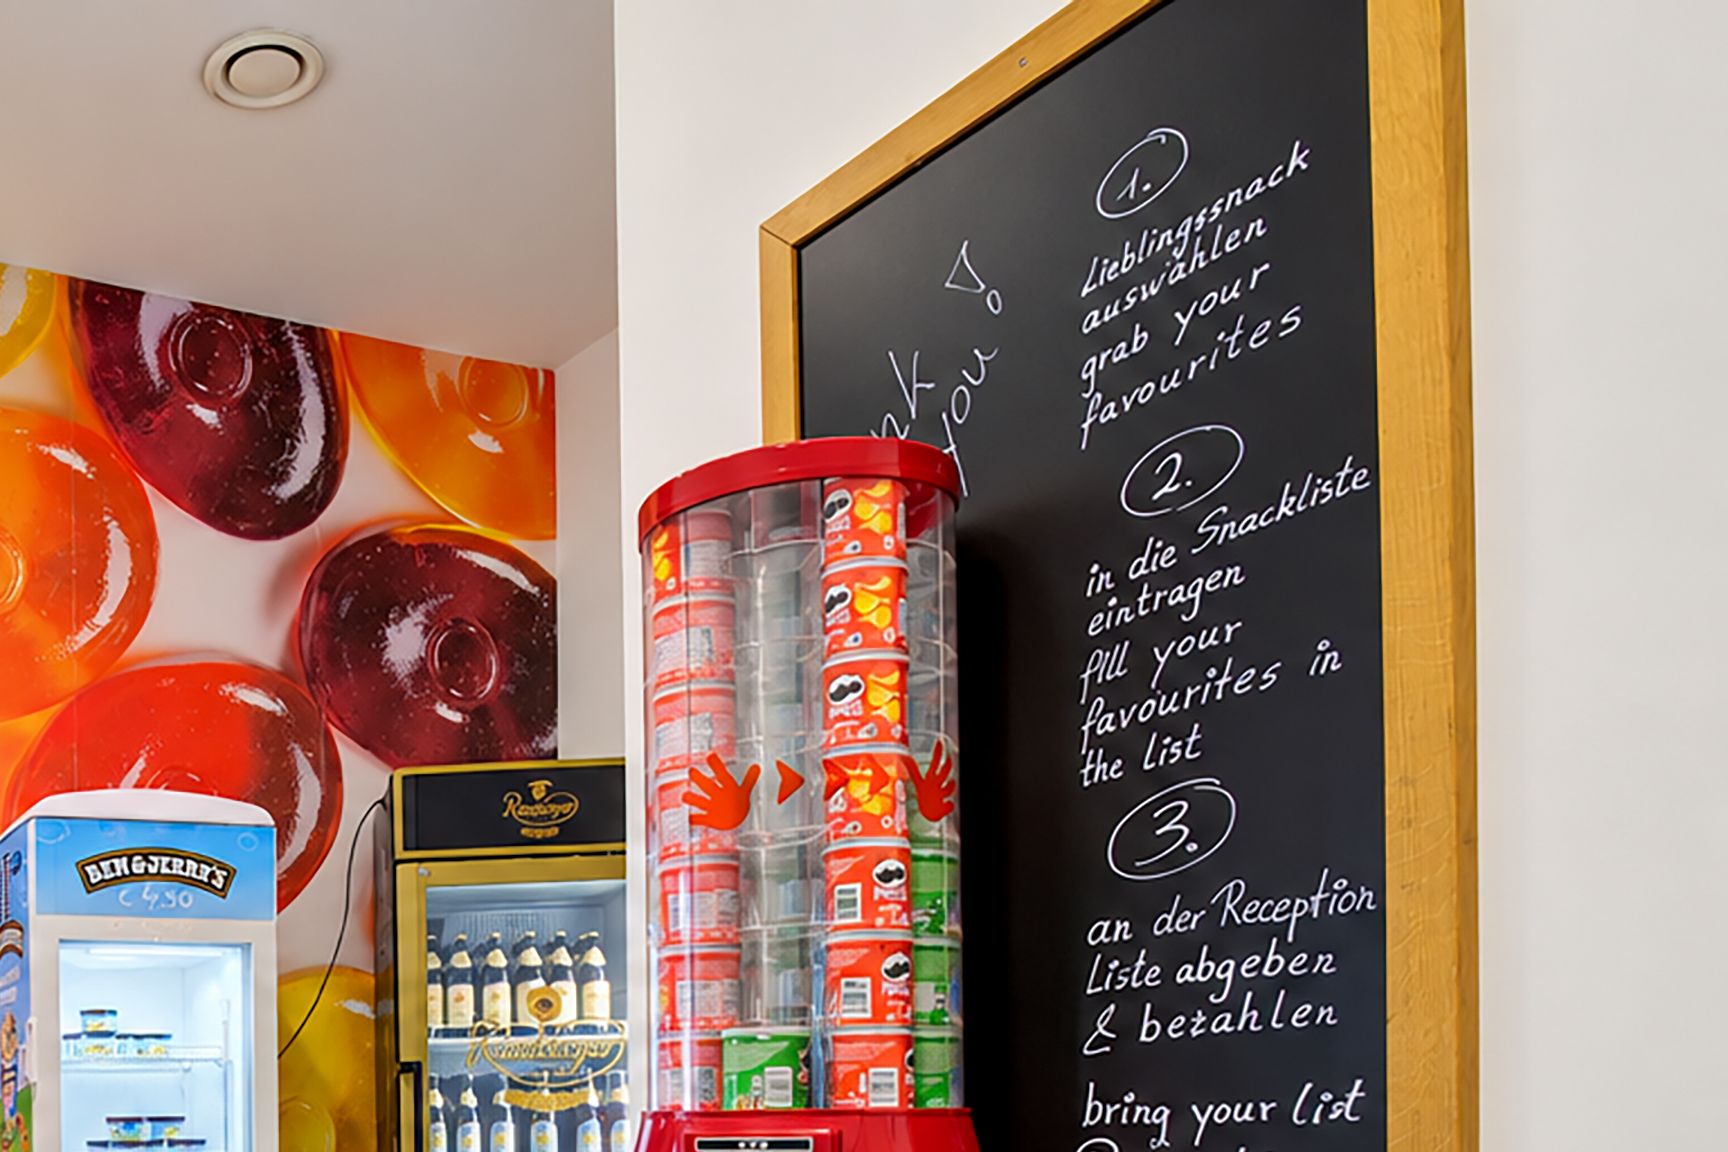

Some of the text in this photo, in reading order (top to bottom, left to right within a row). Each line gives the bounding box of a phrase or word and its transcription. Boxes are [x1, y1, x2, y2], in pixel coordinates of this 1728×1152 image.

[1080, 140, 1310, 298] Lieblingssnack
[1081, 218, 1267, 335] auswählen
[1081, 262, 1270, 399] grab your
[1080, 305, 1301, 450] favourites
[1151, 452, 1192, 501] 2.
[1086, 455, 1371, 597] in die Snackliste
[1087, 565, 1246, 637] eintragen
[1080, 621, 1243, 705] fill your
[1081, 639, 1343, 755] favourites in
[1080, 723, 1203, 787] the list
[1135, 800, 1198, 867] 3.
[1087, 867, 1377, 946] an der Reception
[1086, 937, 1336, 1004] Liste abgeben
[1082, 989, 1338, 1055] & bezahlen
[1082, 1078, 1367, 1150] bring your list
